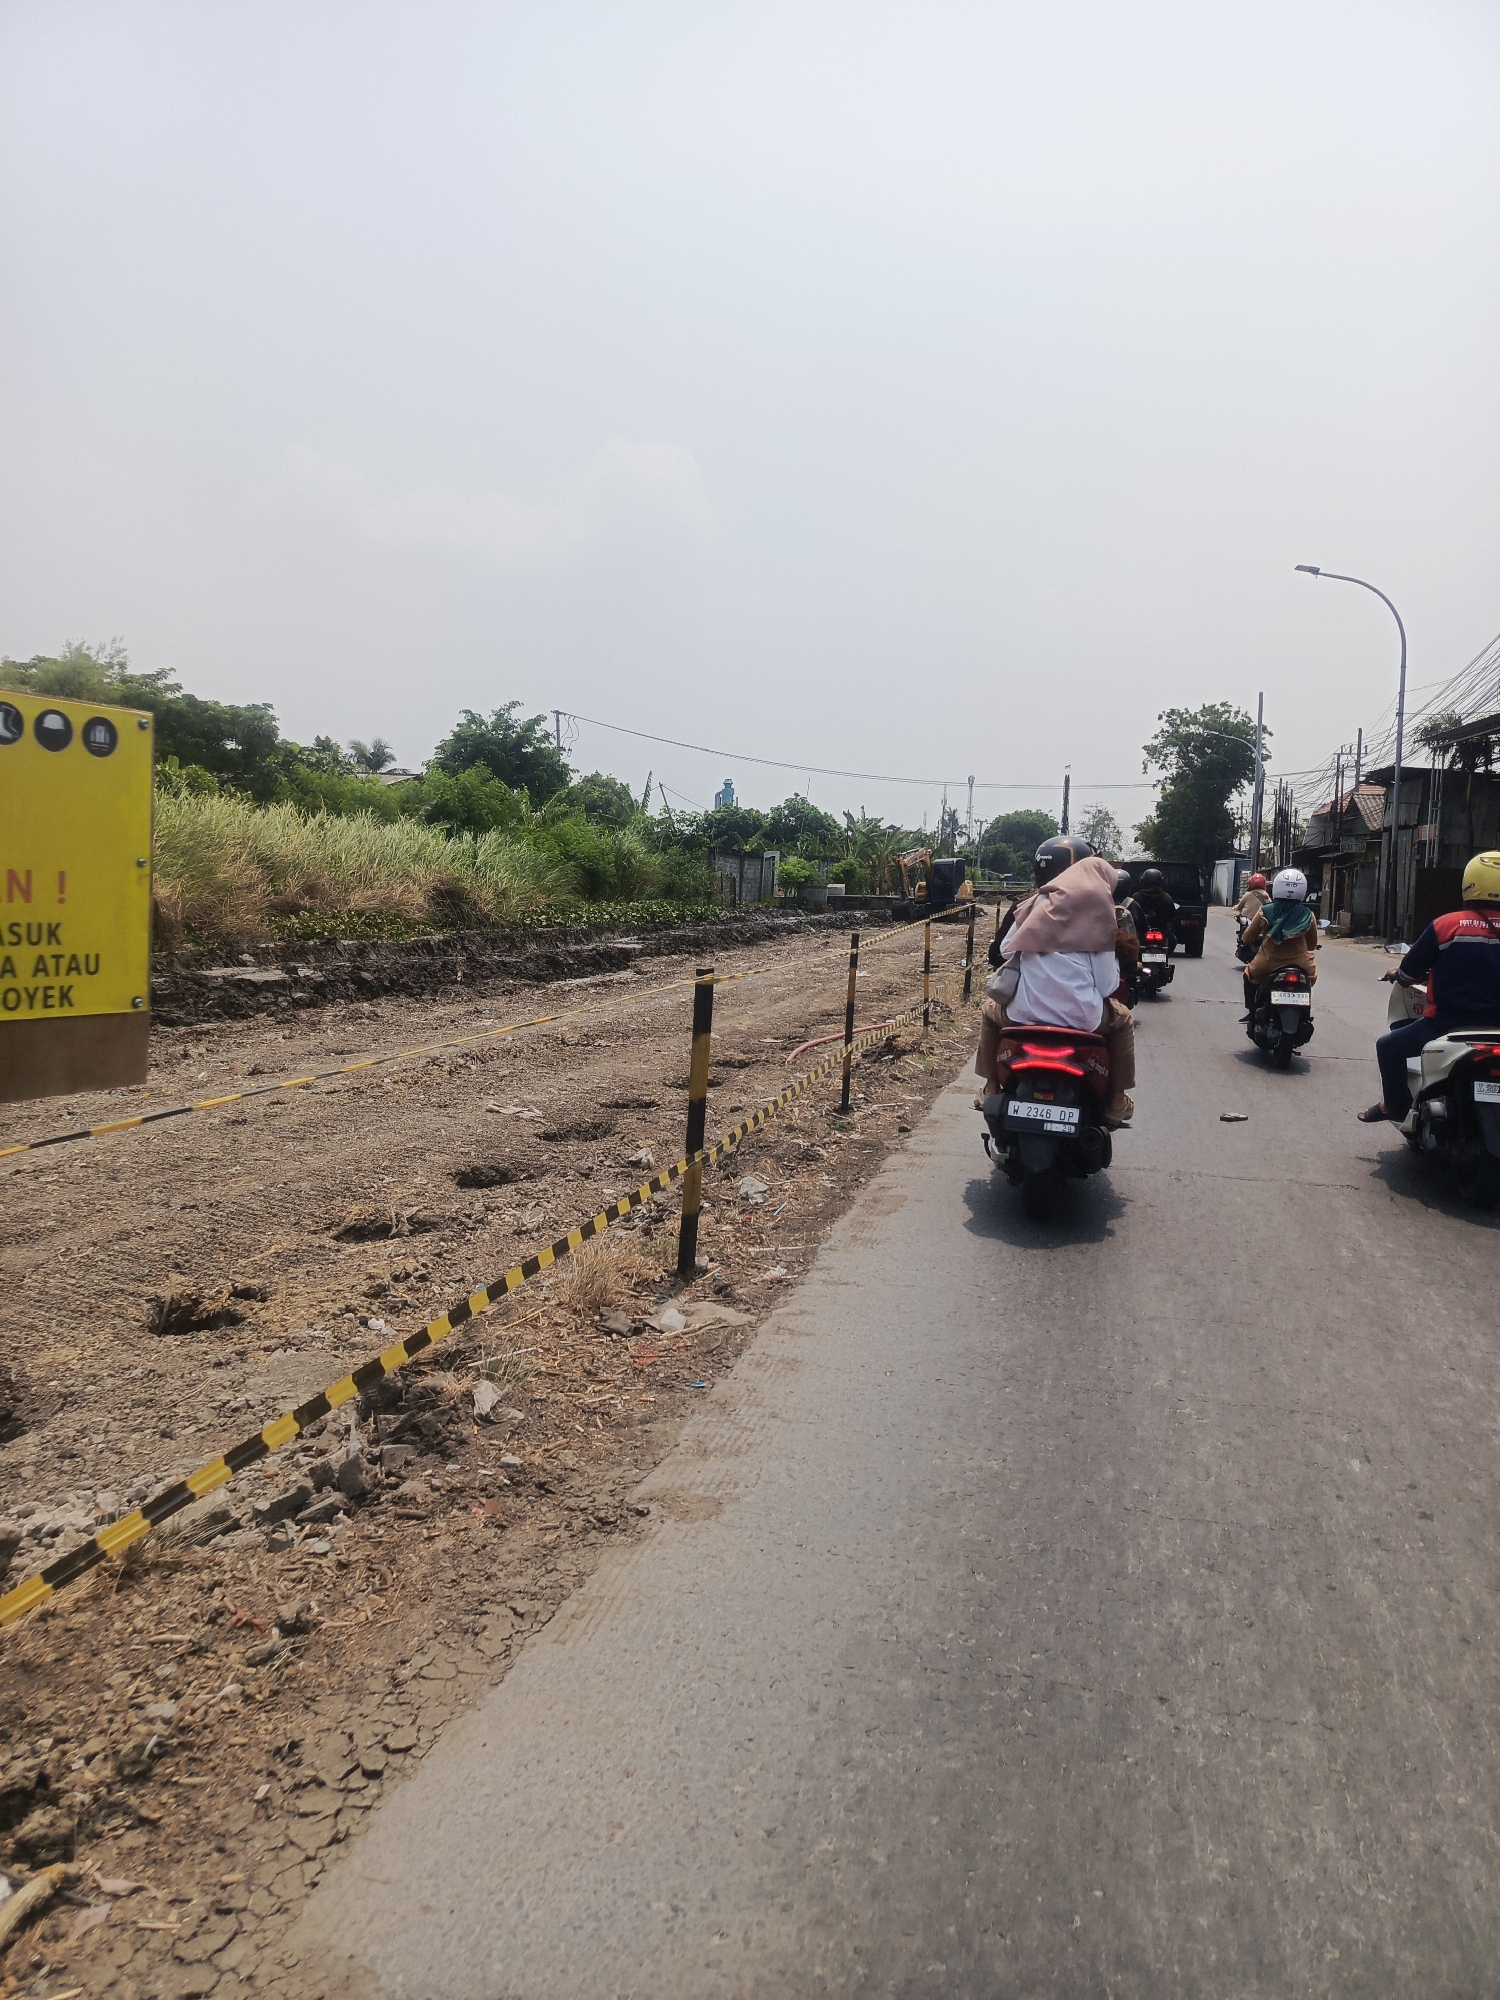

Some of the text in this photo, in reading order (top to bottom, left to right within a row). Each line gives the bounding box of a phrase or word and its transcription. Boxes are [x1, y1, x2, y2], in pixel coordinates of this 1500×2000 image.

[0, 869, 33, 904] N
[32, 953, 100, 978] ATAU
[2, 985, 74, 1011] OYEK
[1026, 1106, 1052, 1119] 2346
